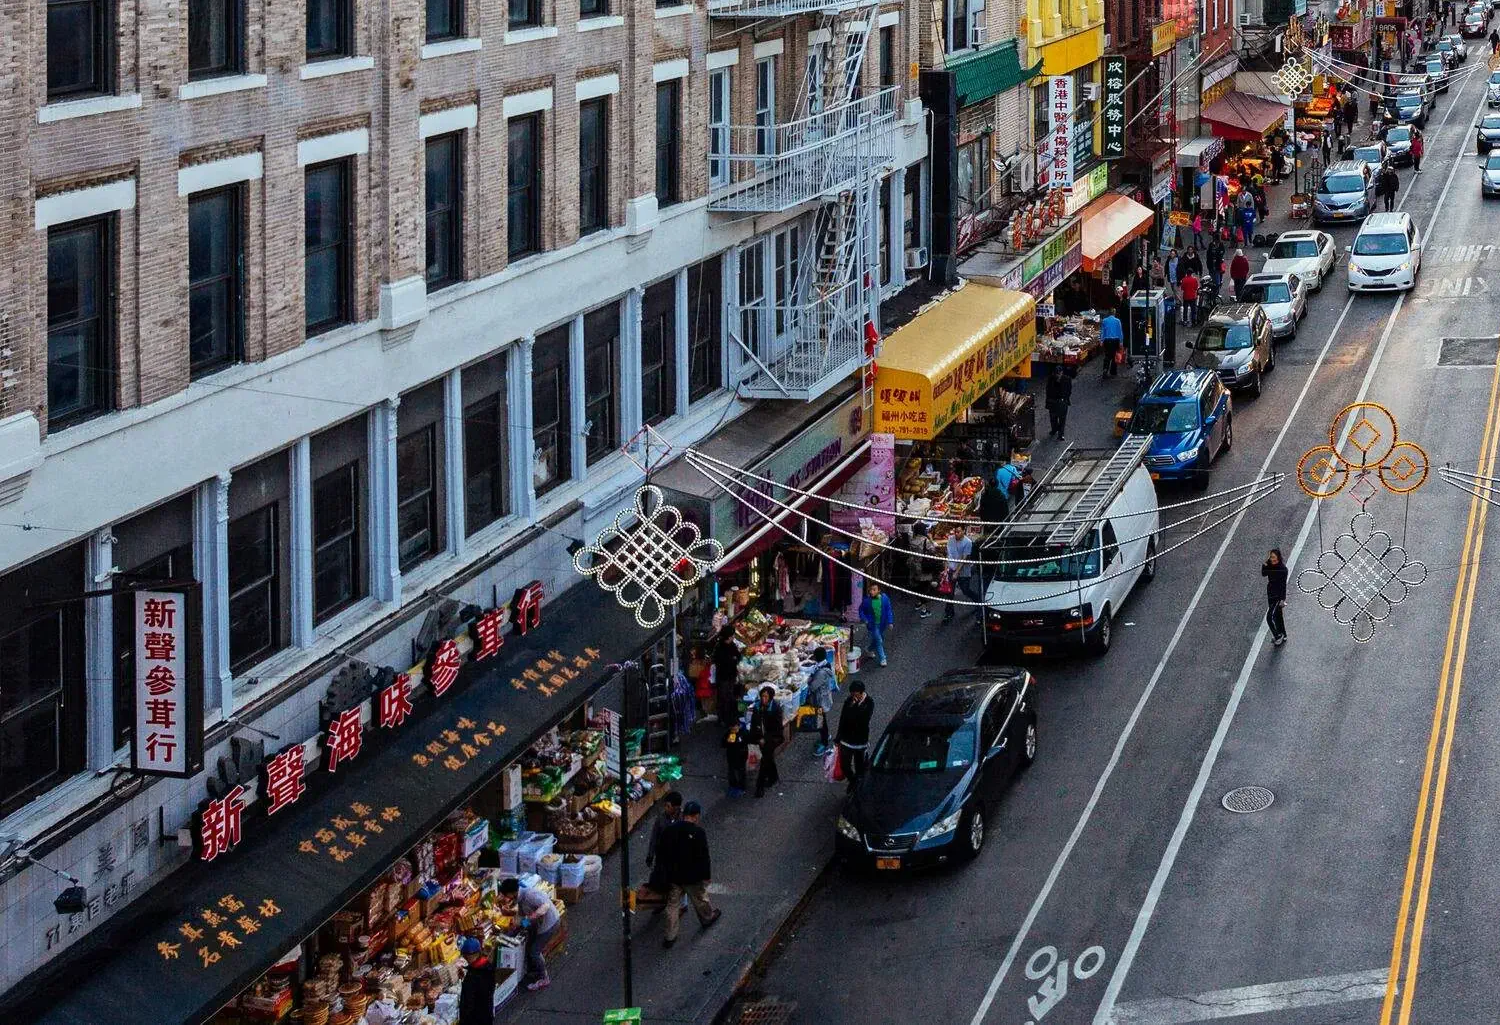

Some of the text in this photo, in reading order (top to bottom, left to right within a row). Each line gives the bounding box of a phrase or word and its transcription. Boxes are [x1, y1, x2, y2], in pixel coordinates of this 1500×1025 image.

[1053, 77, 1068, 181] 香港中醫骨傷科診所
[1107, 61, 1123, 153] 欣榕服務中心
[881, 410, 928, 424] 福州小吃店
[144, 598, 177, 763] 新聲參茸行
[201, 579, 545, 862] 新聲海味參茸行
